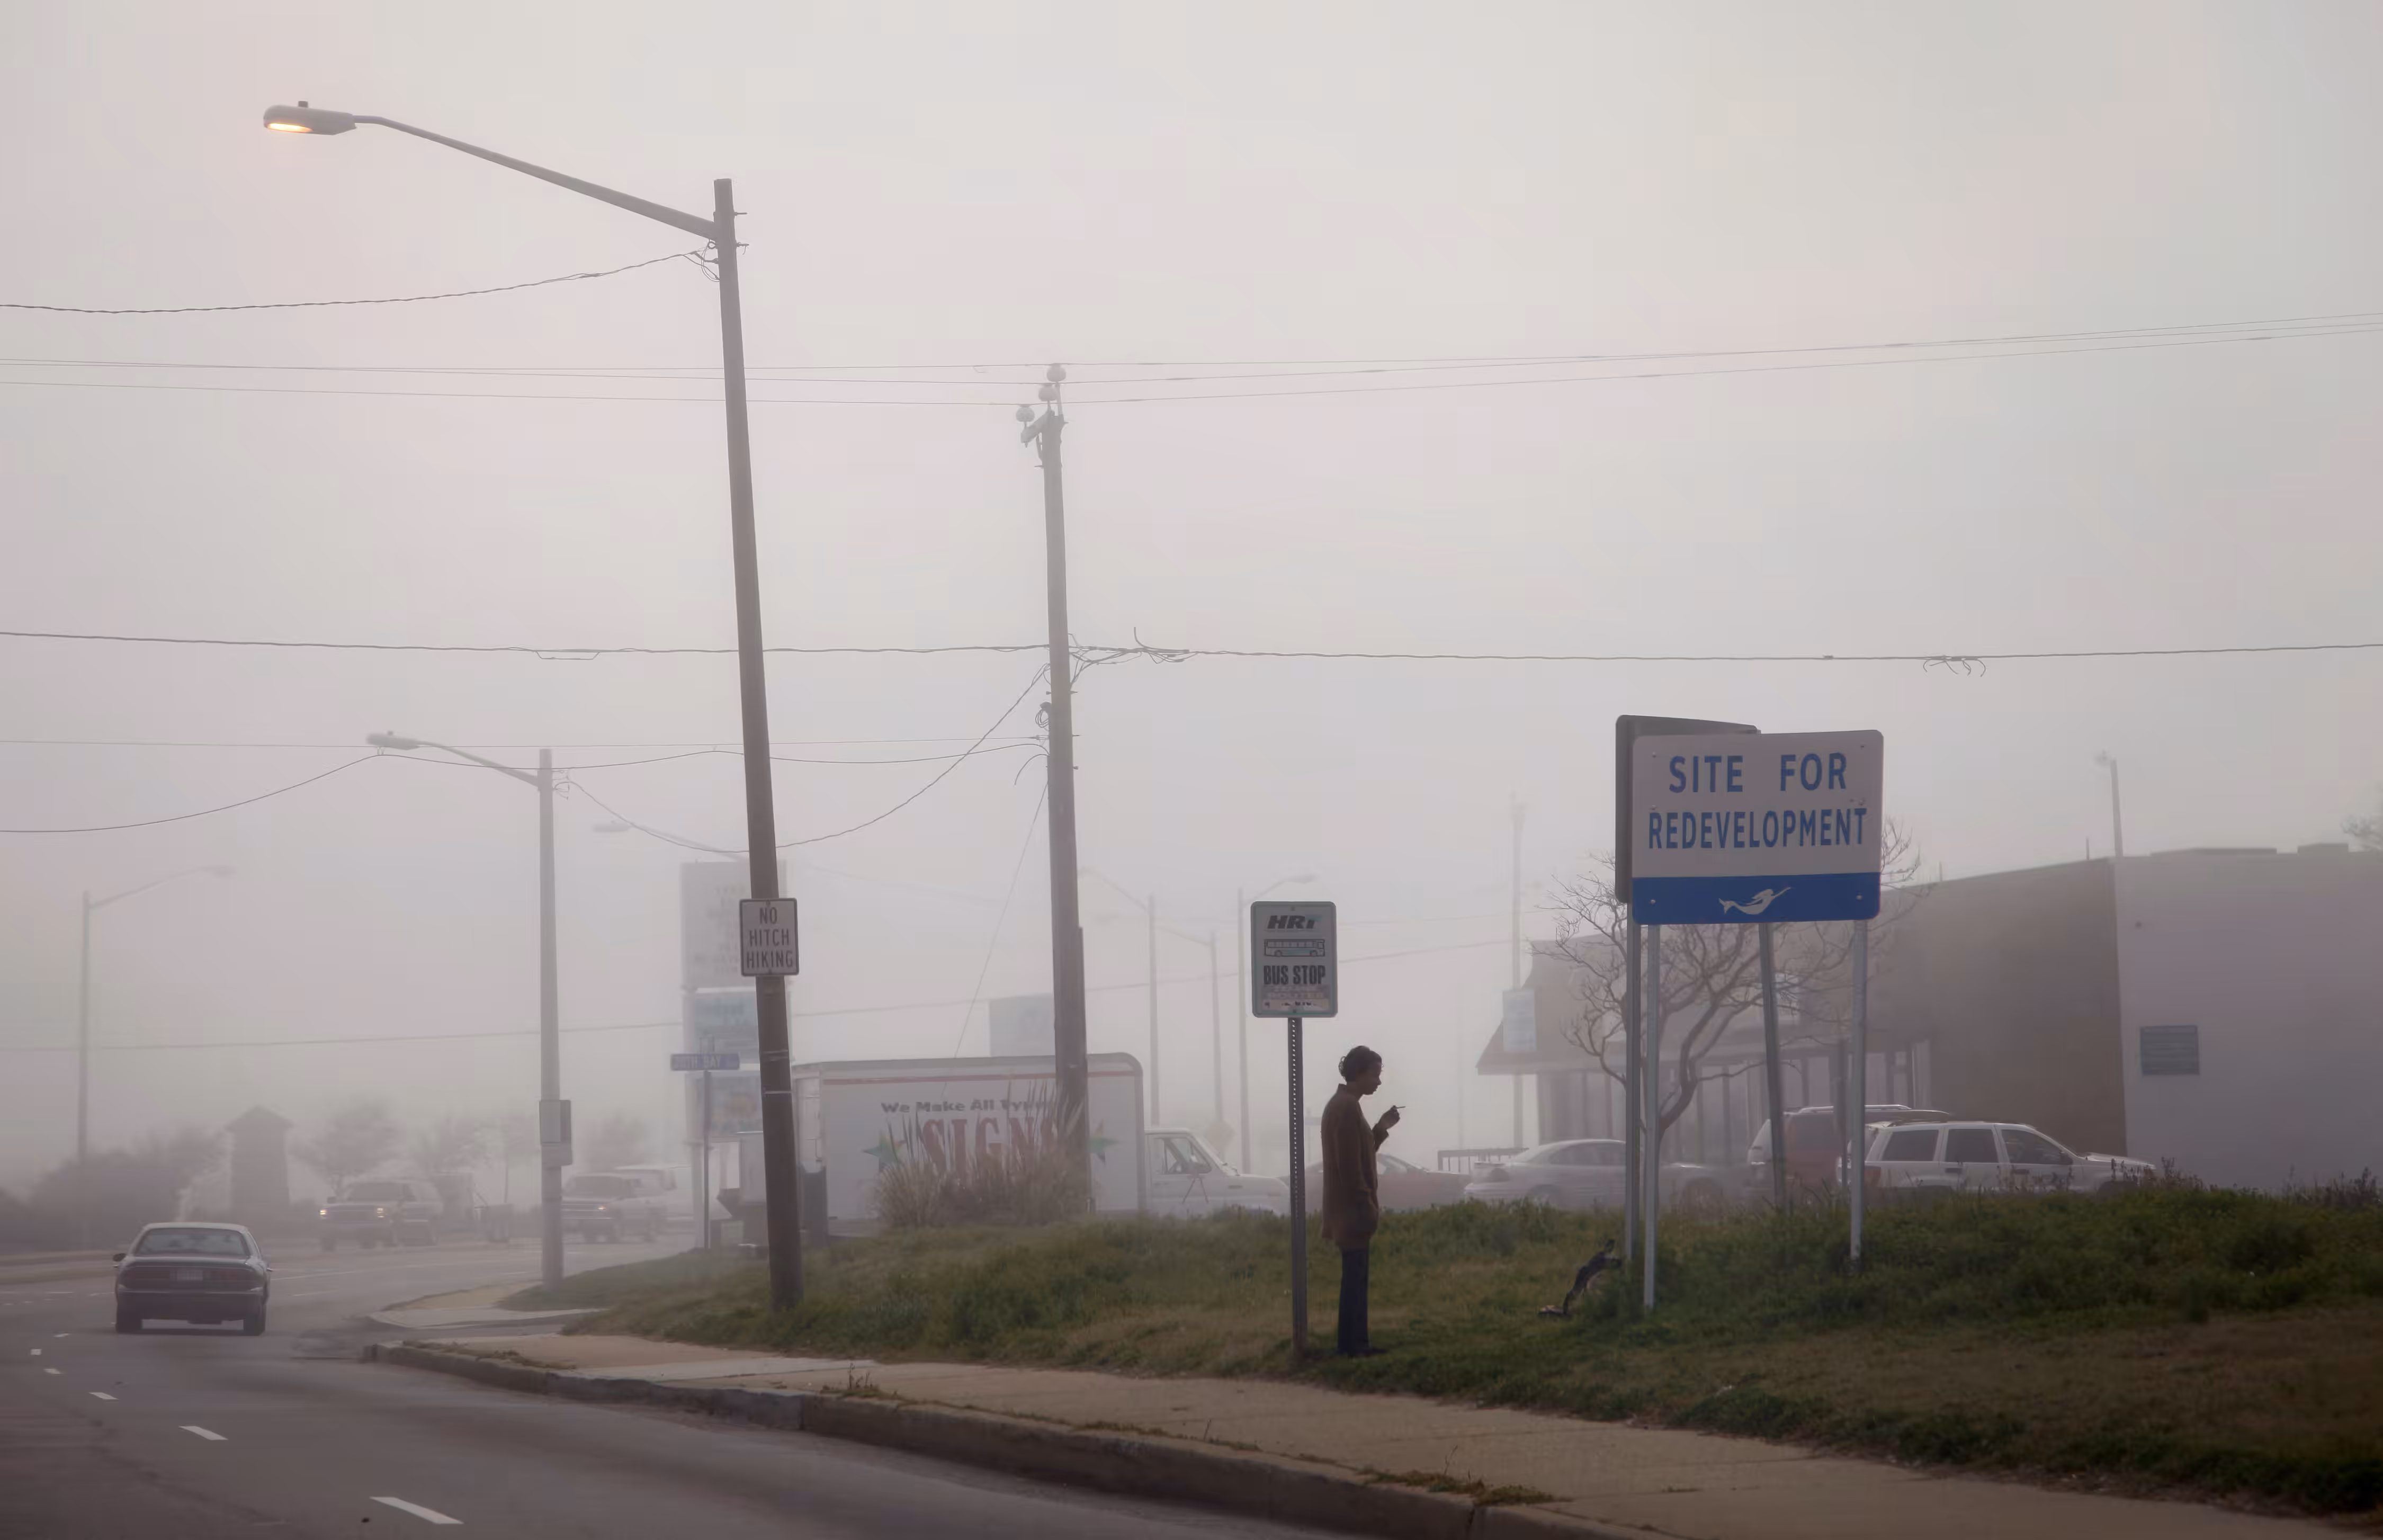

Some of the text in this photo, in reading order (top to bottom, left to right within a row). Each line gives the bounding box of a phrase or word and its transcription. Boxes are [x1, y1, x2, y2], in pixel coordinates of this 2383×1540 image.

[1669, 752, 1847, 793] SITE FOR
[1649, 808, 1868, 849] REDEVELOPMENT
[759, 907, 777, 924] NO
[1266, 915, 1322, 929] HRT
[749, 928, 790, 947] HITCH
[747, 950, 793, 969] HIKING
[1264, 965, 1326, 985] BUS STOP
[703, 1055, 721, 1068] BAY
[881, 1098, 1055, 1113] We Make All Typ
